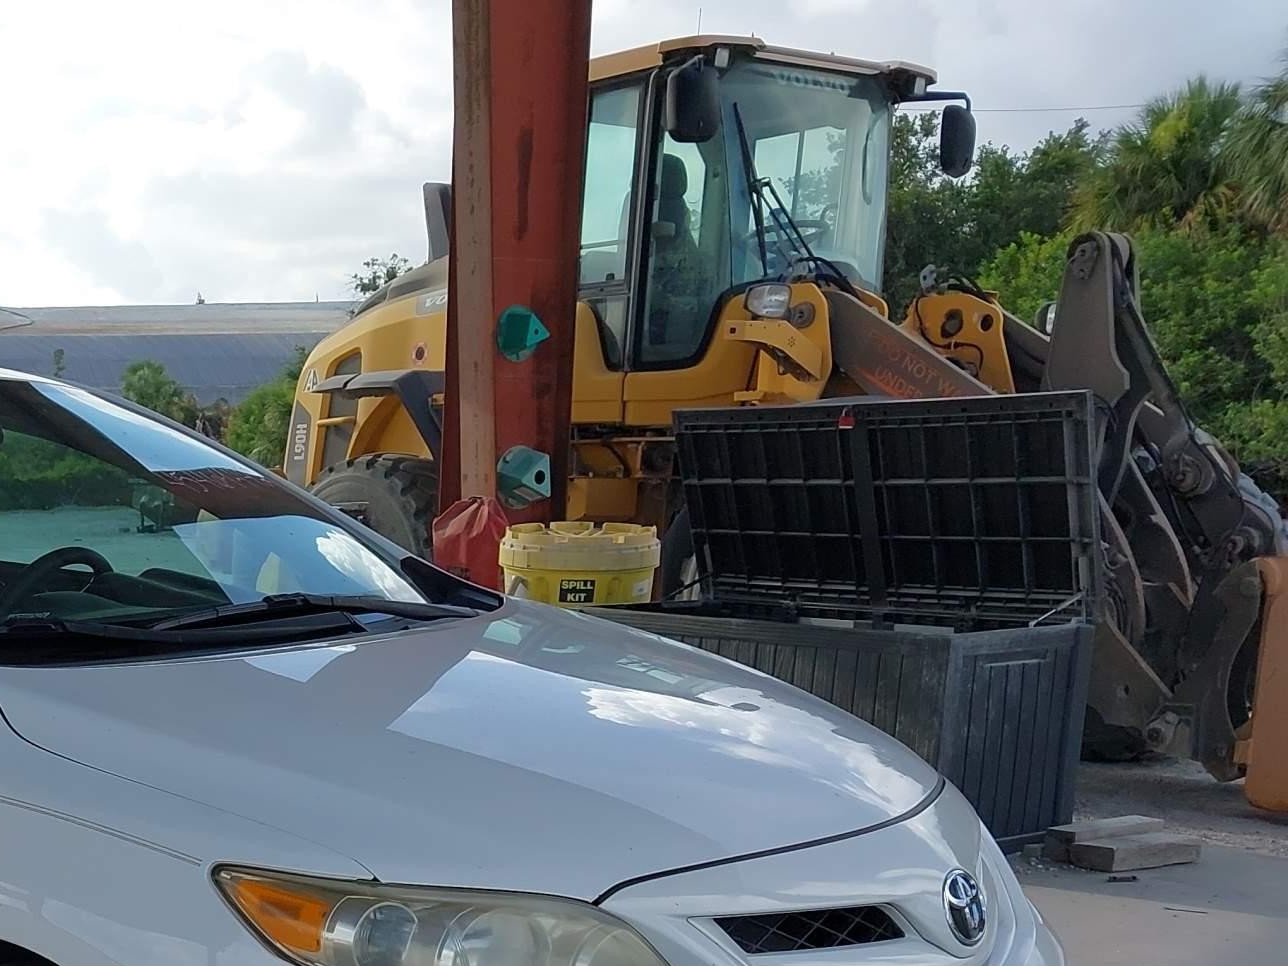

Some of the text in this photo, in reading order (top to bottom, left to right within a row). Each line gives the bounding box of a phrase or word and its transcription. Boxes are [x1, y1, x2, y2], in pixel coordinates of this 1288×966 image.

[903, 353, 940, 384] NOT
[293, 423, 308, 461] L90H
[561, 580, 594, 590] SPILL
[567, 592, 587, 602] KIT
